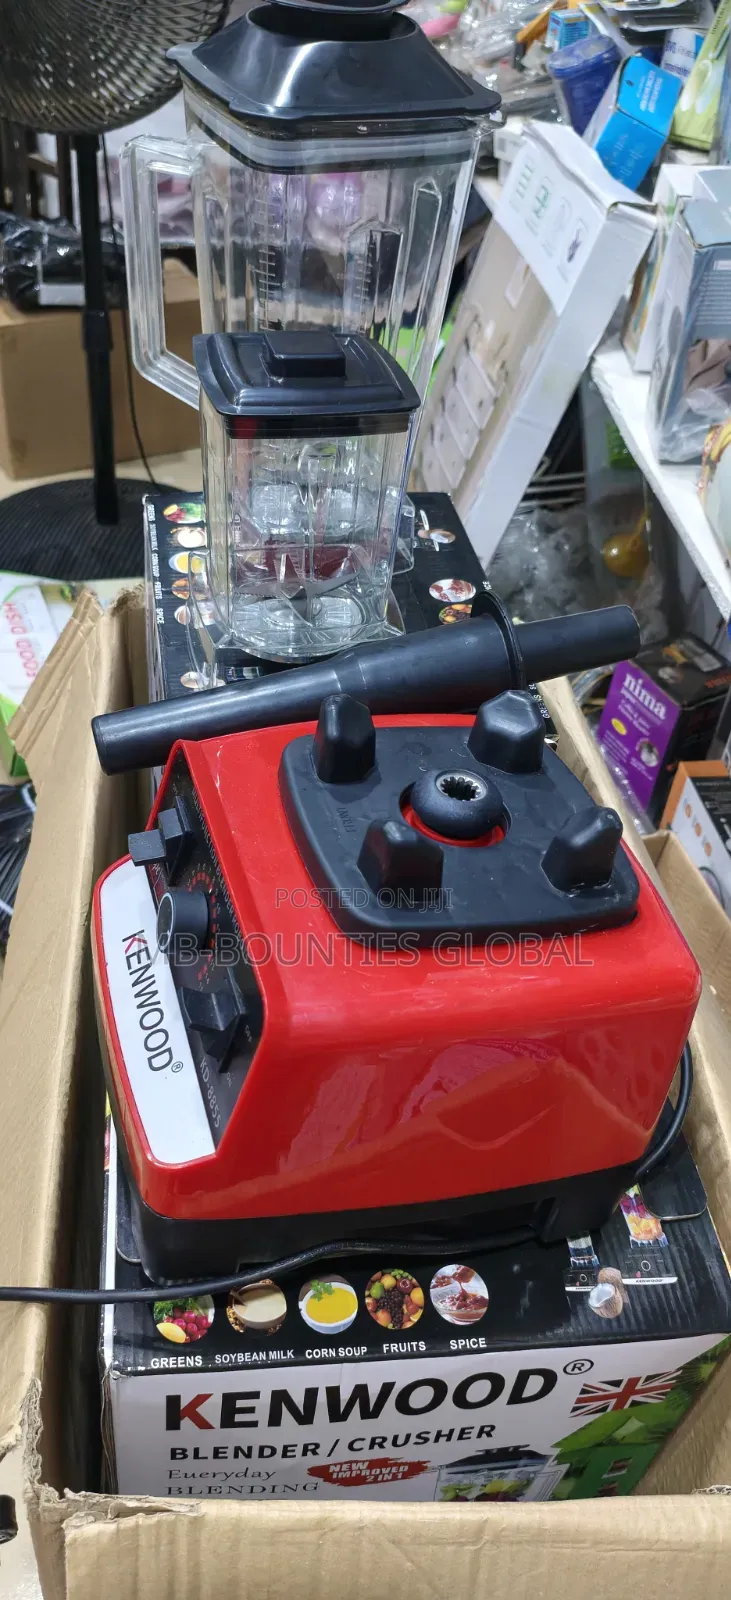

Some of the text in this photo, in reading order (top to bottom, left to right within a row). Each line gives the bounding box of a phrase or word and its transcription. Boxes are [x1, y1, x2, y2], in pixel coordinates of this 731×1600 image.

[156, 607, 165, 624] SPICE
[622, 672, 667, 720] nima
[122, 929, 174, 1073] KENWOOD
[199, 1055, 221, 1128] KD-8855
[383, 1341, 426, 1354] FRUITS
[449, 1337, 487, 1350] SPICE
[215, 1349, 295, 1364] SOYBEAN MILK
[305, 1346, 368, 1359] CORN SOUP
[150, 1356, 203, 1369] GREENS
[166, 1368, 557, 1431] KENWOOD
[170, 1442, 321, 1460] BLENDER
[347, 1424, 496, 1452] CRUSHER
[329, 1461, 369, 1472] NEW
[332, 1465, 409, 1479] IMPROVED
[378, 1473, 392, 1481] IN
[165, 1481, 320, 1496] BLENDING
